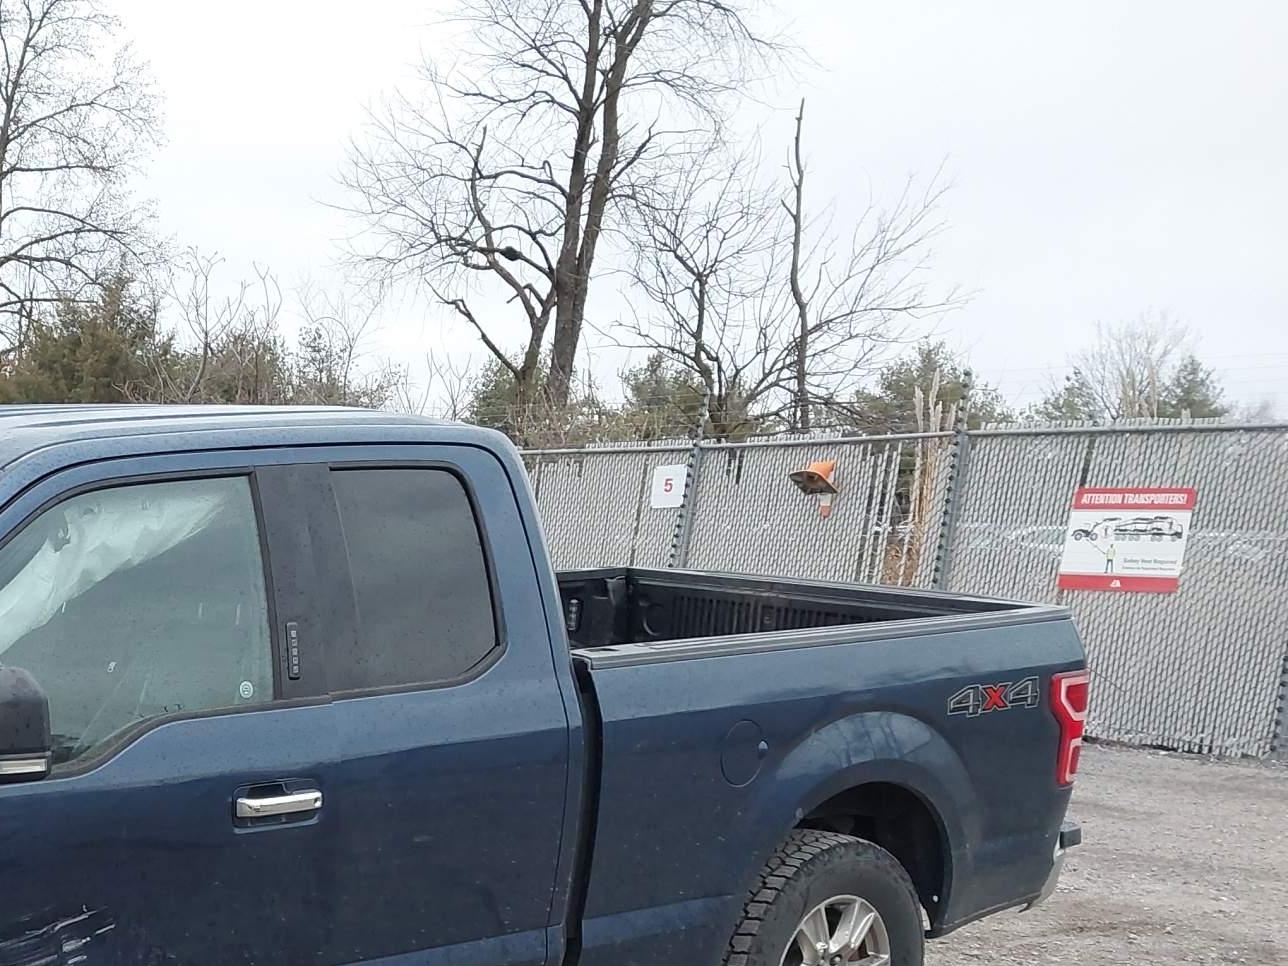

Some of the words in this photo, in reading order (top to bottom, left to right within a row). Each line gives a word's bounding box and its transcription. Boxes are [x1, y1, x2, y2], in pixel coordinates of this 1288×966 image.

[663, 478, 674, 493] 5
[1080, 493, 1123, 505] ATTENTION
[1123, 493, 1189, 505] TRANSPORTERS!
